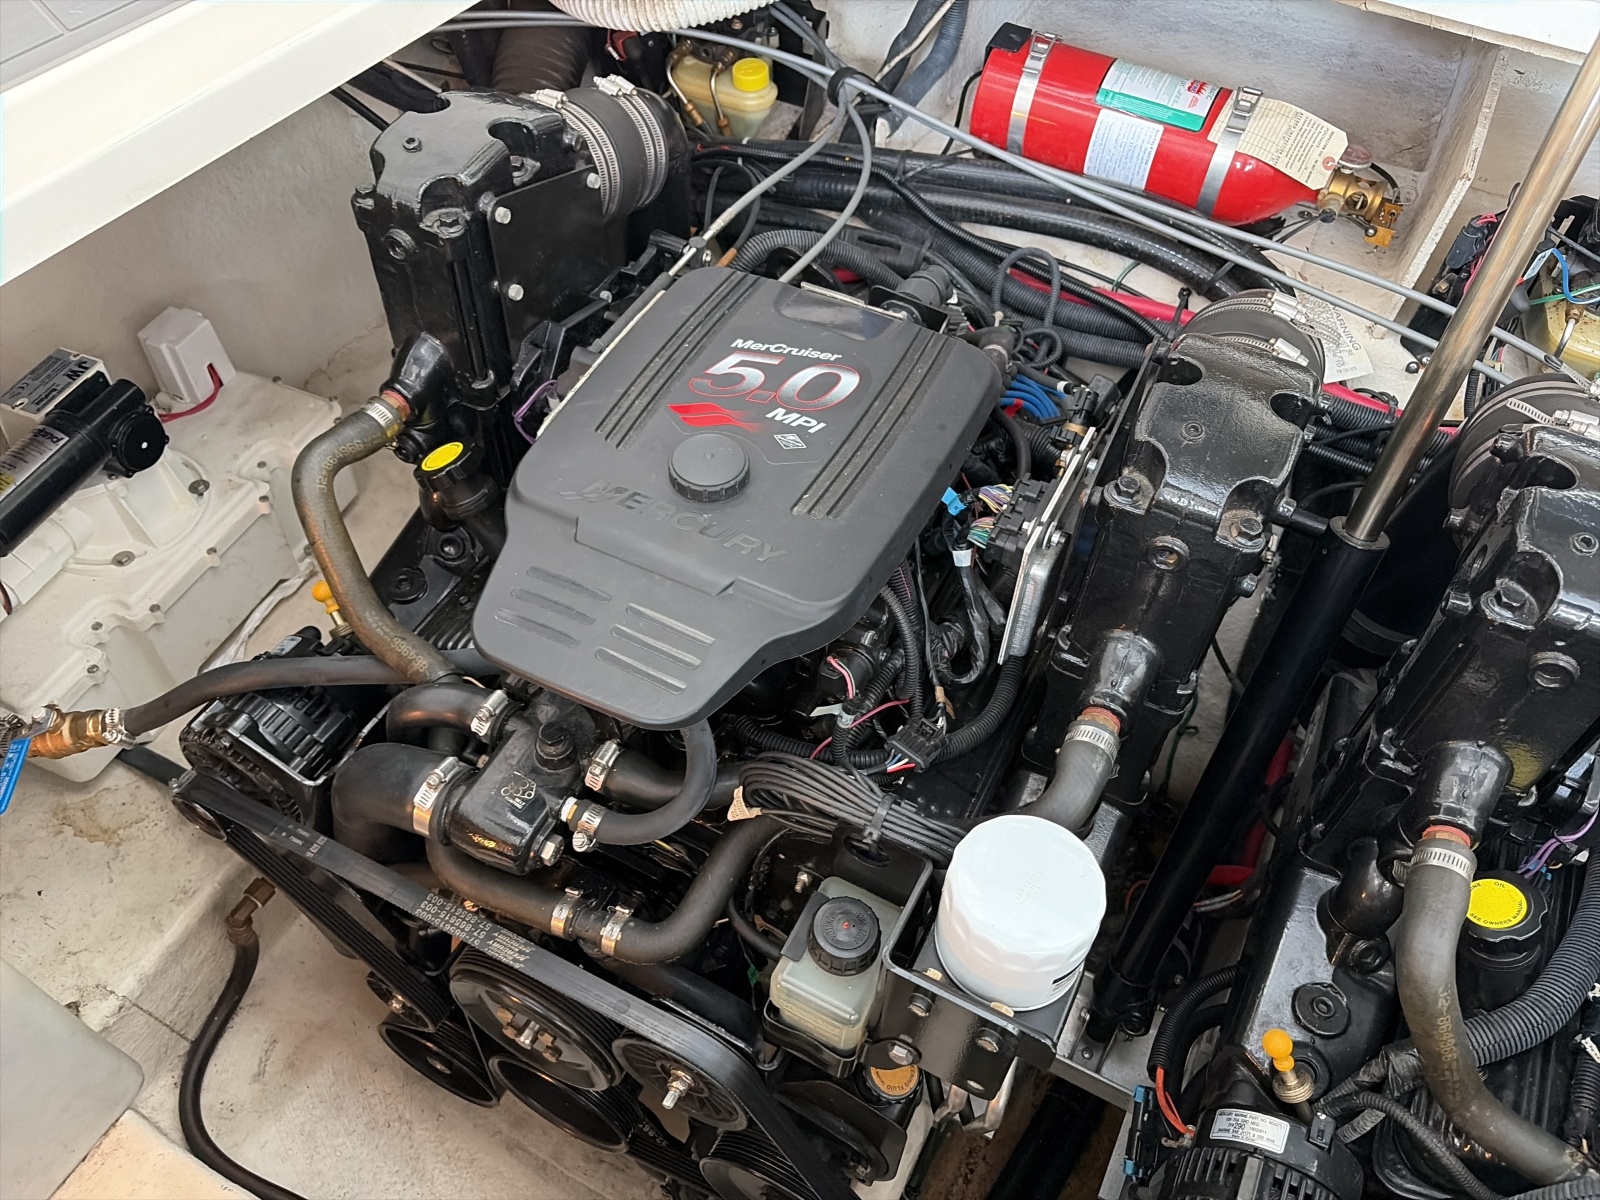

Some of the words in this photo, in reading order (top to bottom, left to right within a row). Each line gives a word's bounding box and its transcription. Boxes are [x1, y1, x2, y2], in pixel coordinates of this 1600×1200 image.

[730, 338, 843, 362] MerCruiser
[62, 360, 90, 382] JW
[688, 351, 861, 411] 5.0
[765, 407, 827, 434] MPI
[557, 479, 788, 563] MERCURY
[390, 637, 431, 679] -864966
[1494, 881, 1506, 889] OIL
[420, 900, 486, 939] 57-865615-003
[426, 893, 492, 931] 57-865615-003
[1470, 913, 1482, 921] SEE
[487, 940, 530, 961] MERCURY
[492, 931, 536, 953] MERCURY
